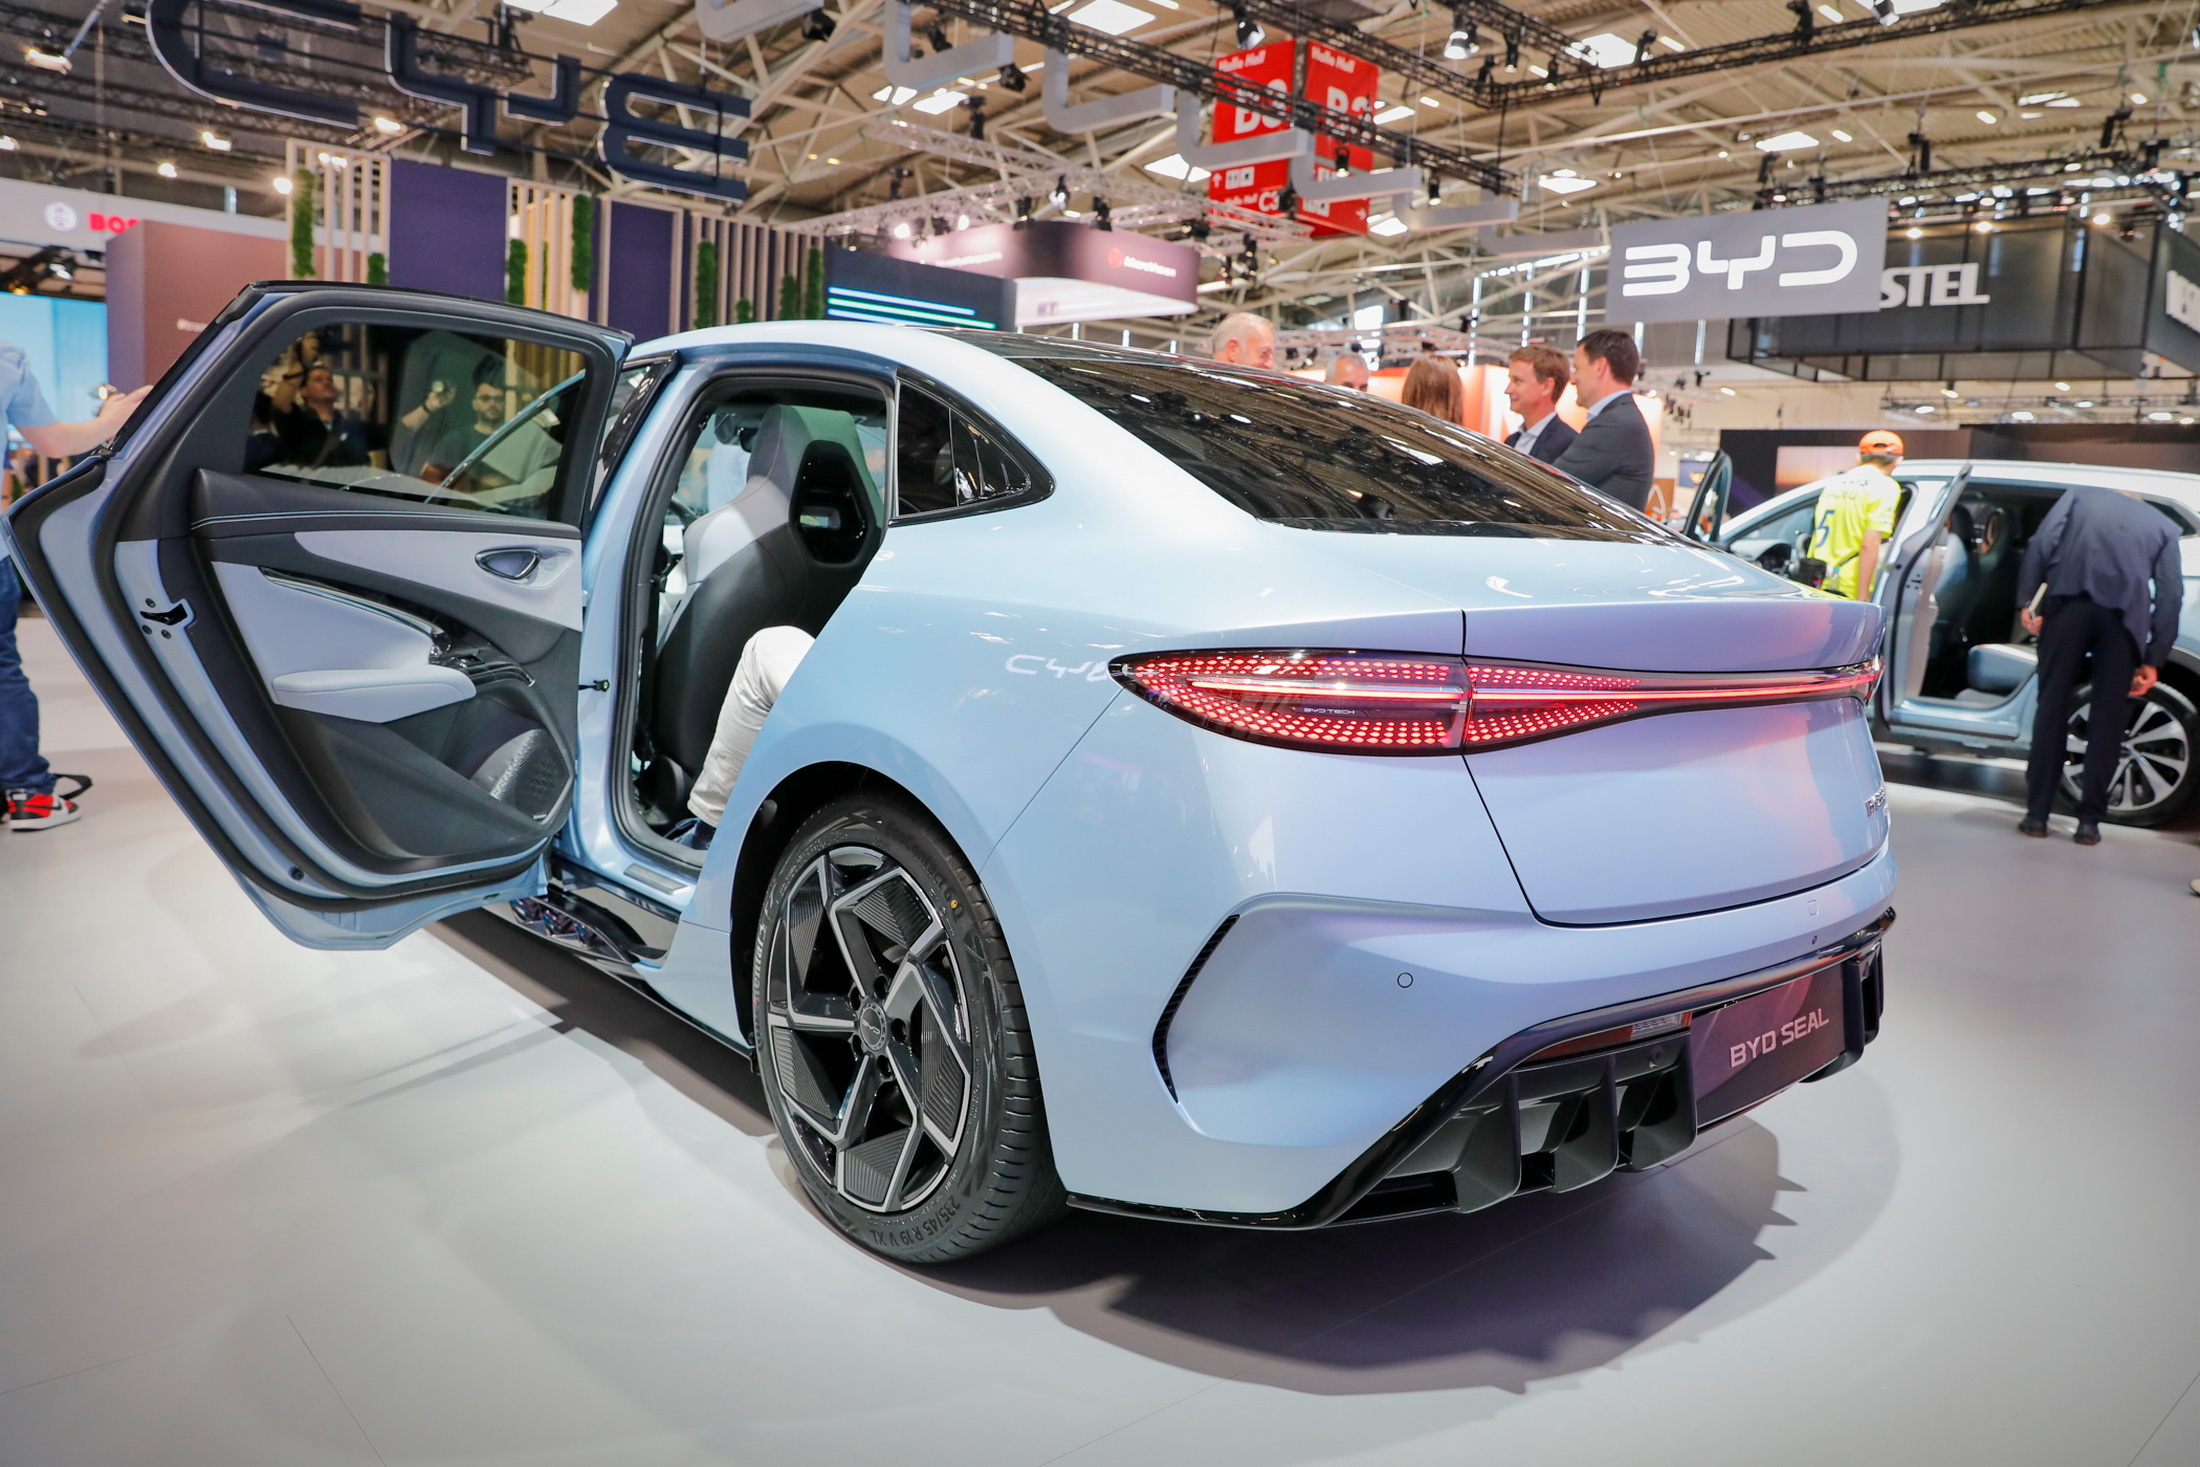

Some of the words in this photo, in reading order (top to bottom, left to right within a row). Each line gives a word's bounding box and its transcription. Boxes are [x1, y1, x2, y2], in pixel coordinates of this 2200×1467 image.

[1622, 230, 1858, 297] BYD
[1730, 1030, 1777, 1068] BYD
[1780, 1008, 1830, 1046] SEAL
